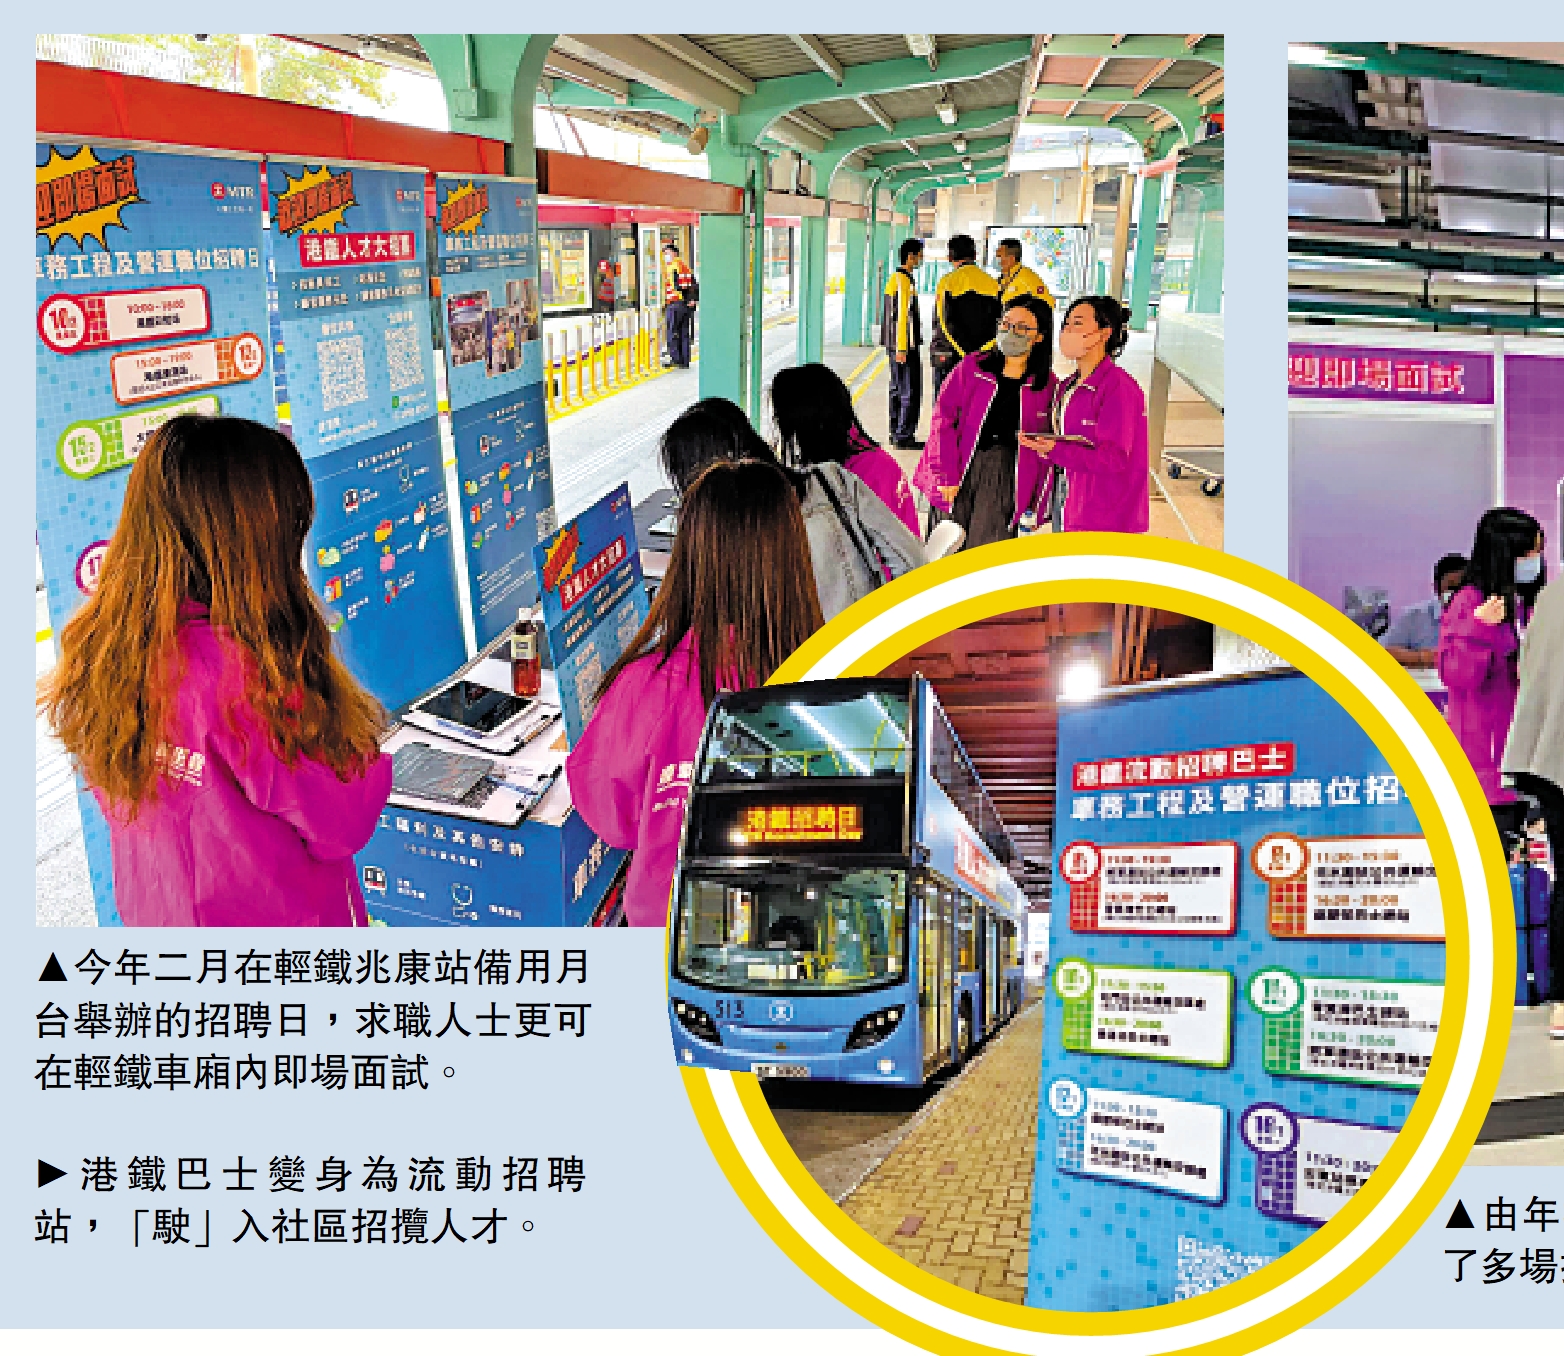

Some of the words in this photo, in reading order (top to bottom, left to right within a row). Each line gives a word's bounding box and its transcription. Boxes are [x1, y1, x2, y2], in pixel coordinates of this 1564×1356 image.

[1070, 773, 1408, 821] 車務工程及營運職位招
[714, 998, 745, 1019] 513
